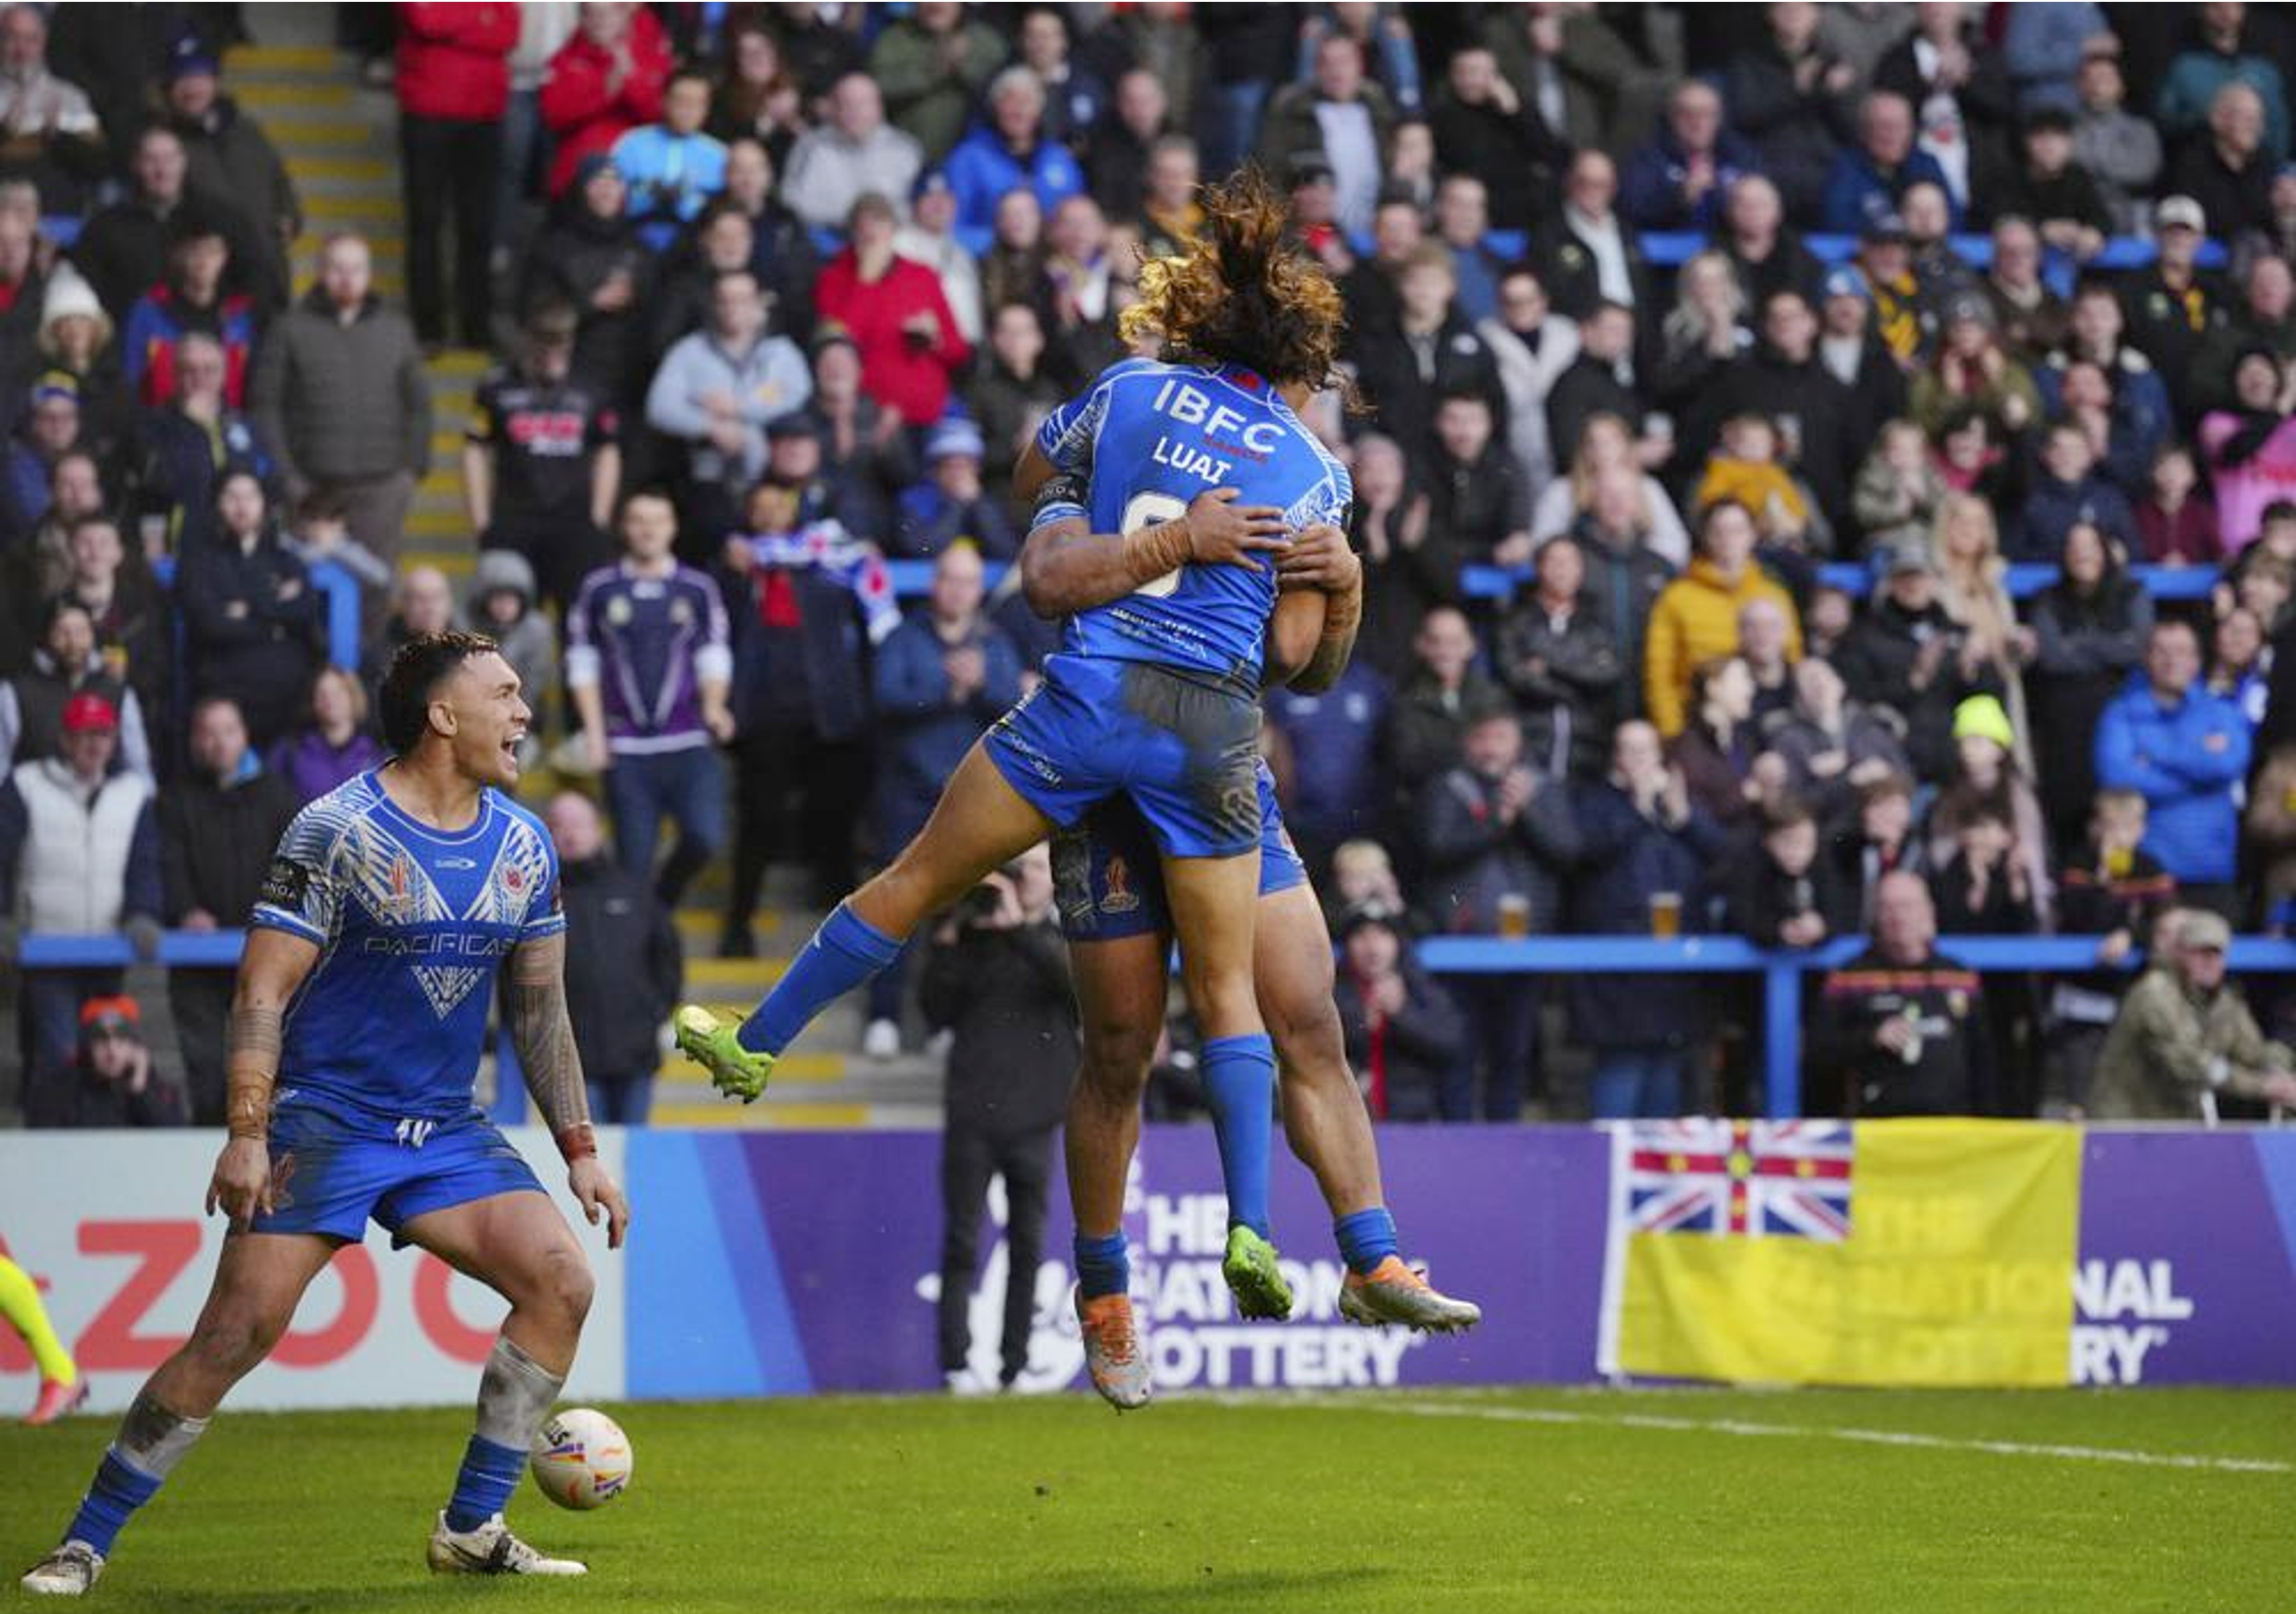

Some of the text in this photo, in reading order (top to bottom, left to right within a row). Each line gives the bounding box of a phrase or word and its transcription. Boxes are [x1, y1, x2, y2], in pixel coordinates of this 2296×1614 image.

[1151, 379, 1287, 454] IBFC
[1151, 436, 1231, 484] LUAI
[1130, 1194, 1229, 1256] HE
[1134, 1324, 1407, 1388] OTTERY
